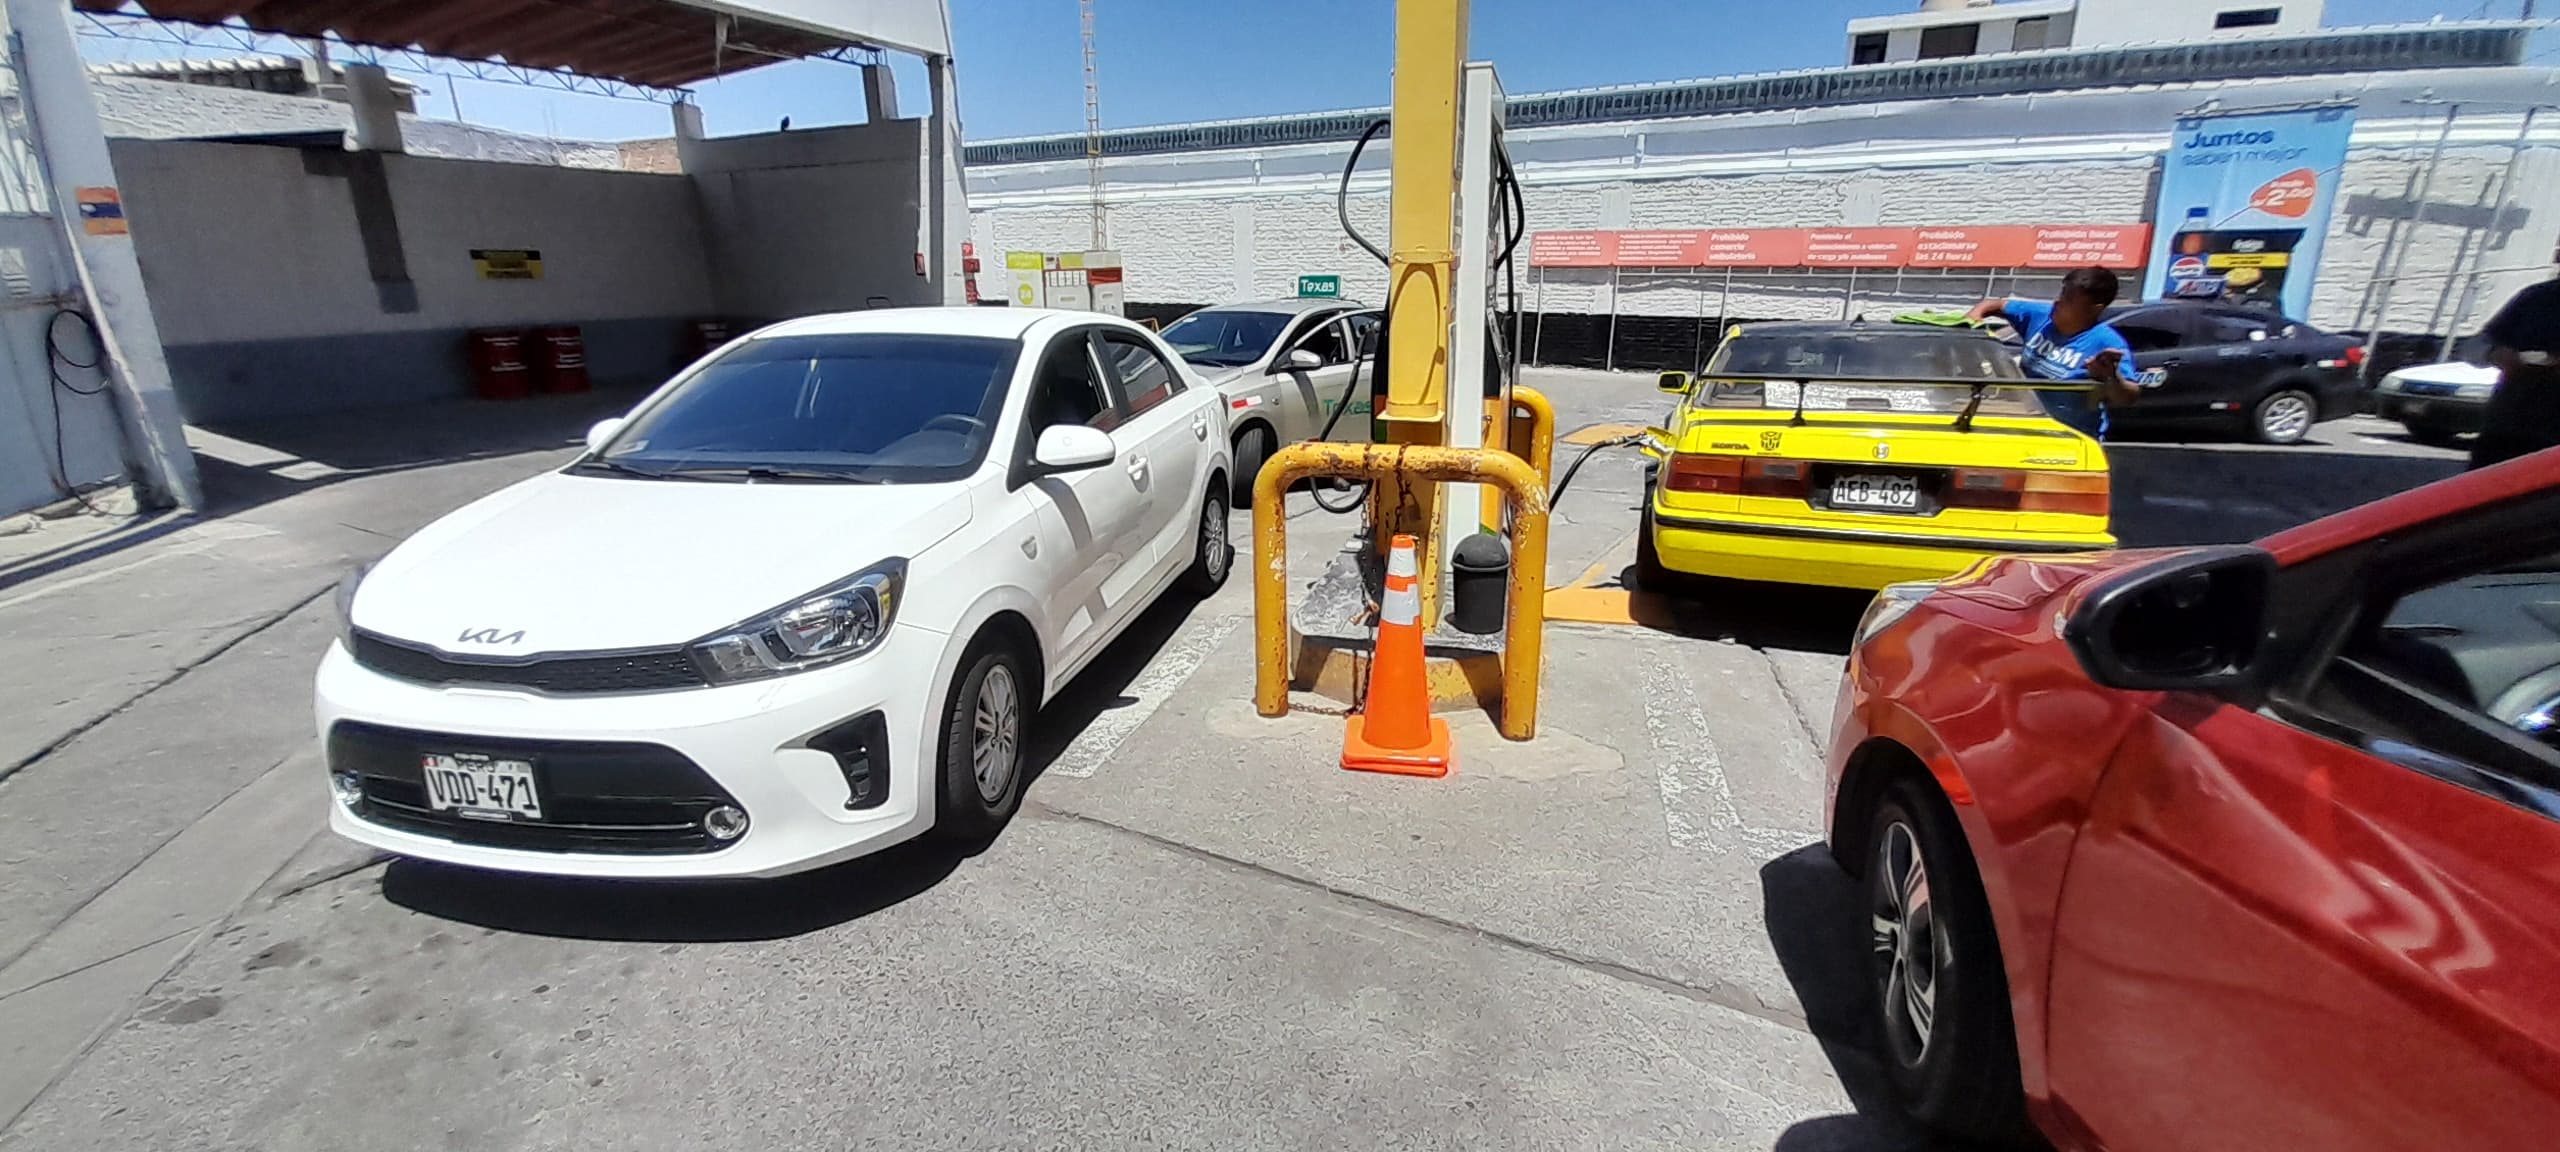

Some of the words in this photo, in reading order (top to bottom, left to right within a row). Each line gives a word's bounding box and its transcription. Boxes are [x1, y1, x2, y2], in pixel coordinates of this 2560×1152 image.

[2184, 130, 2274, 149] Juntos
[1711, 233, 1750, 241] Prohibido
[1918, 231, 1965, 240] Prohibido
[1301, 279, 1335, 292] Texas
[1835, 479, 1914, 506] AEB-482
